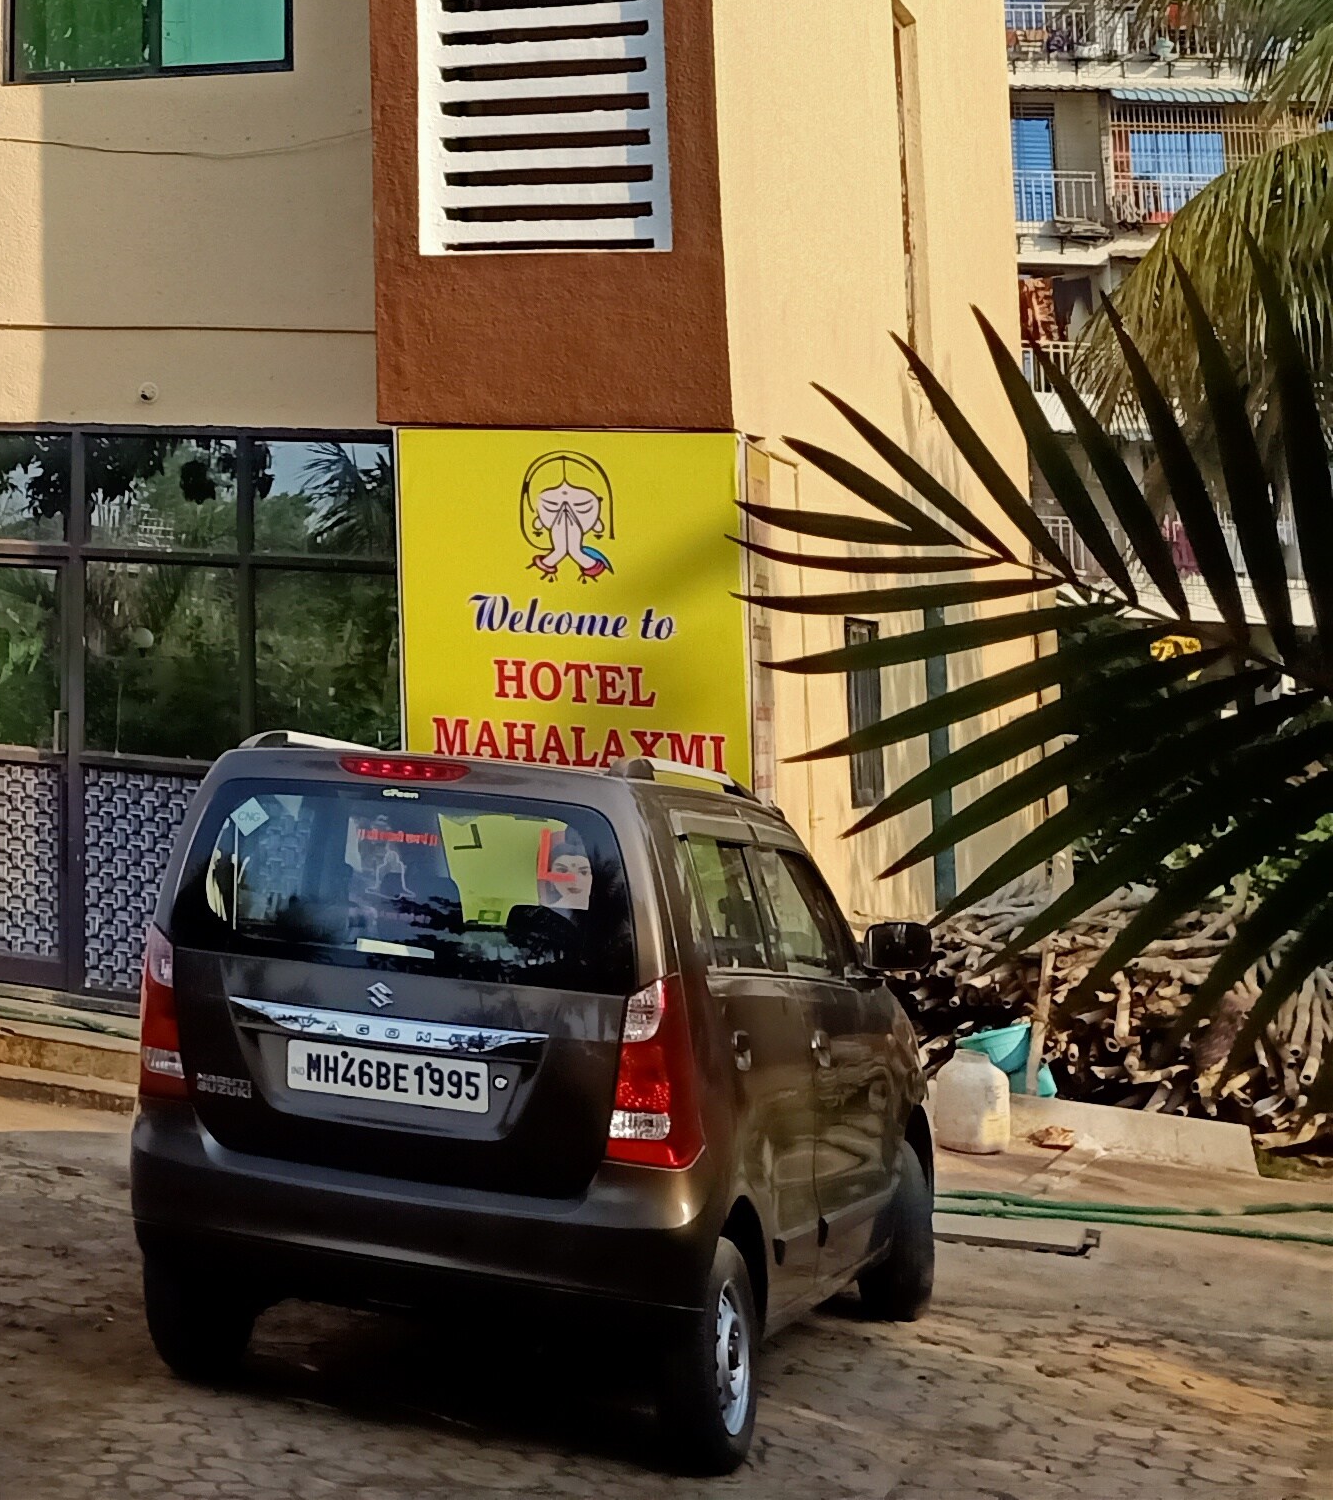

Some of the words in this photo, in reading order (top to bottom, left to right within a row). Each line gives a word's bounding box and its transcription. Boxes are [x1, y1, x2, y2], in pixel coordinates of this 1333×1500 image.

[468, 594, 629, 638] Welcome
[641, 607, 676, 641] to
[494, 659, 656, 708] HOTEL
[433, 717, 728, 774] MAHALAXMI
[237, 811, 261, 822] CNG
[197, 1081, 252, 1099] SUZUKI
